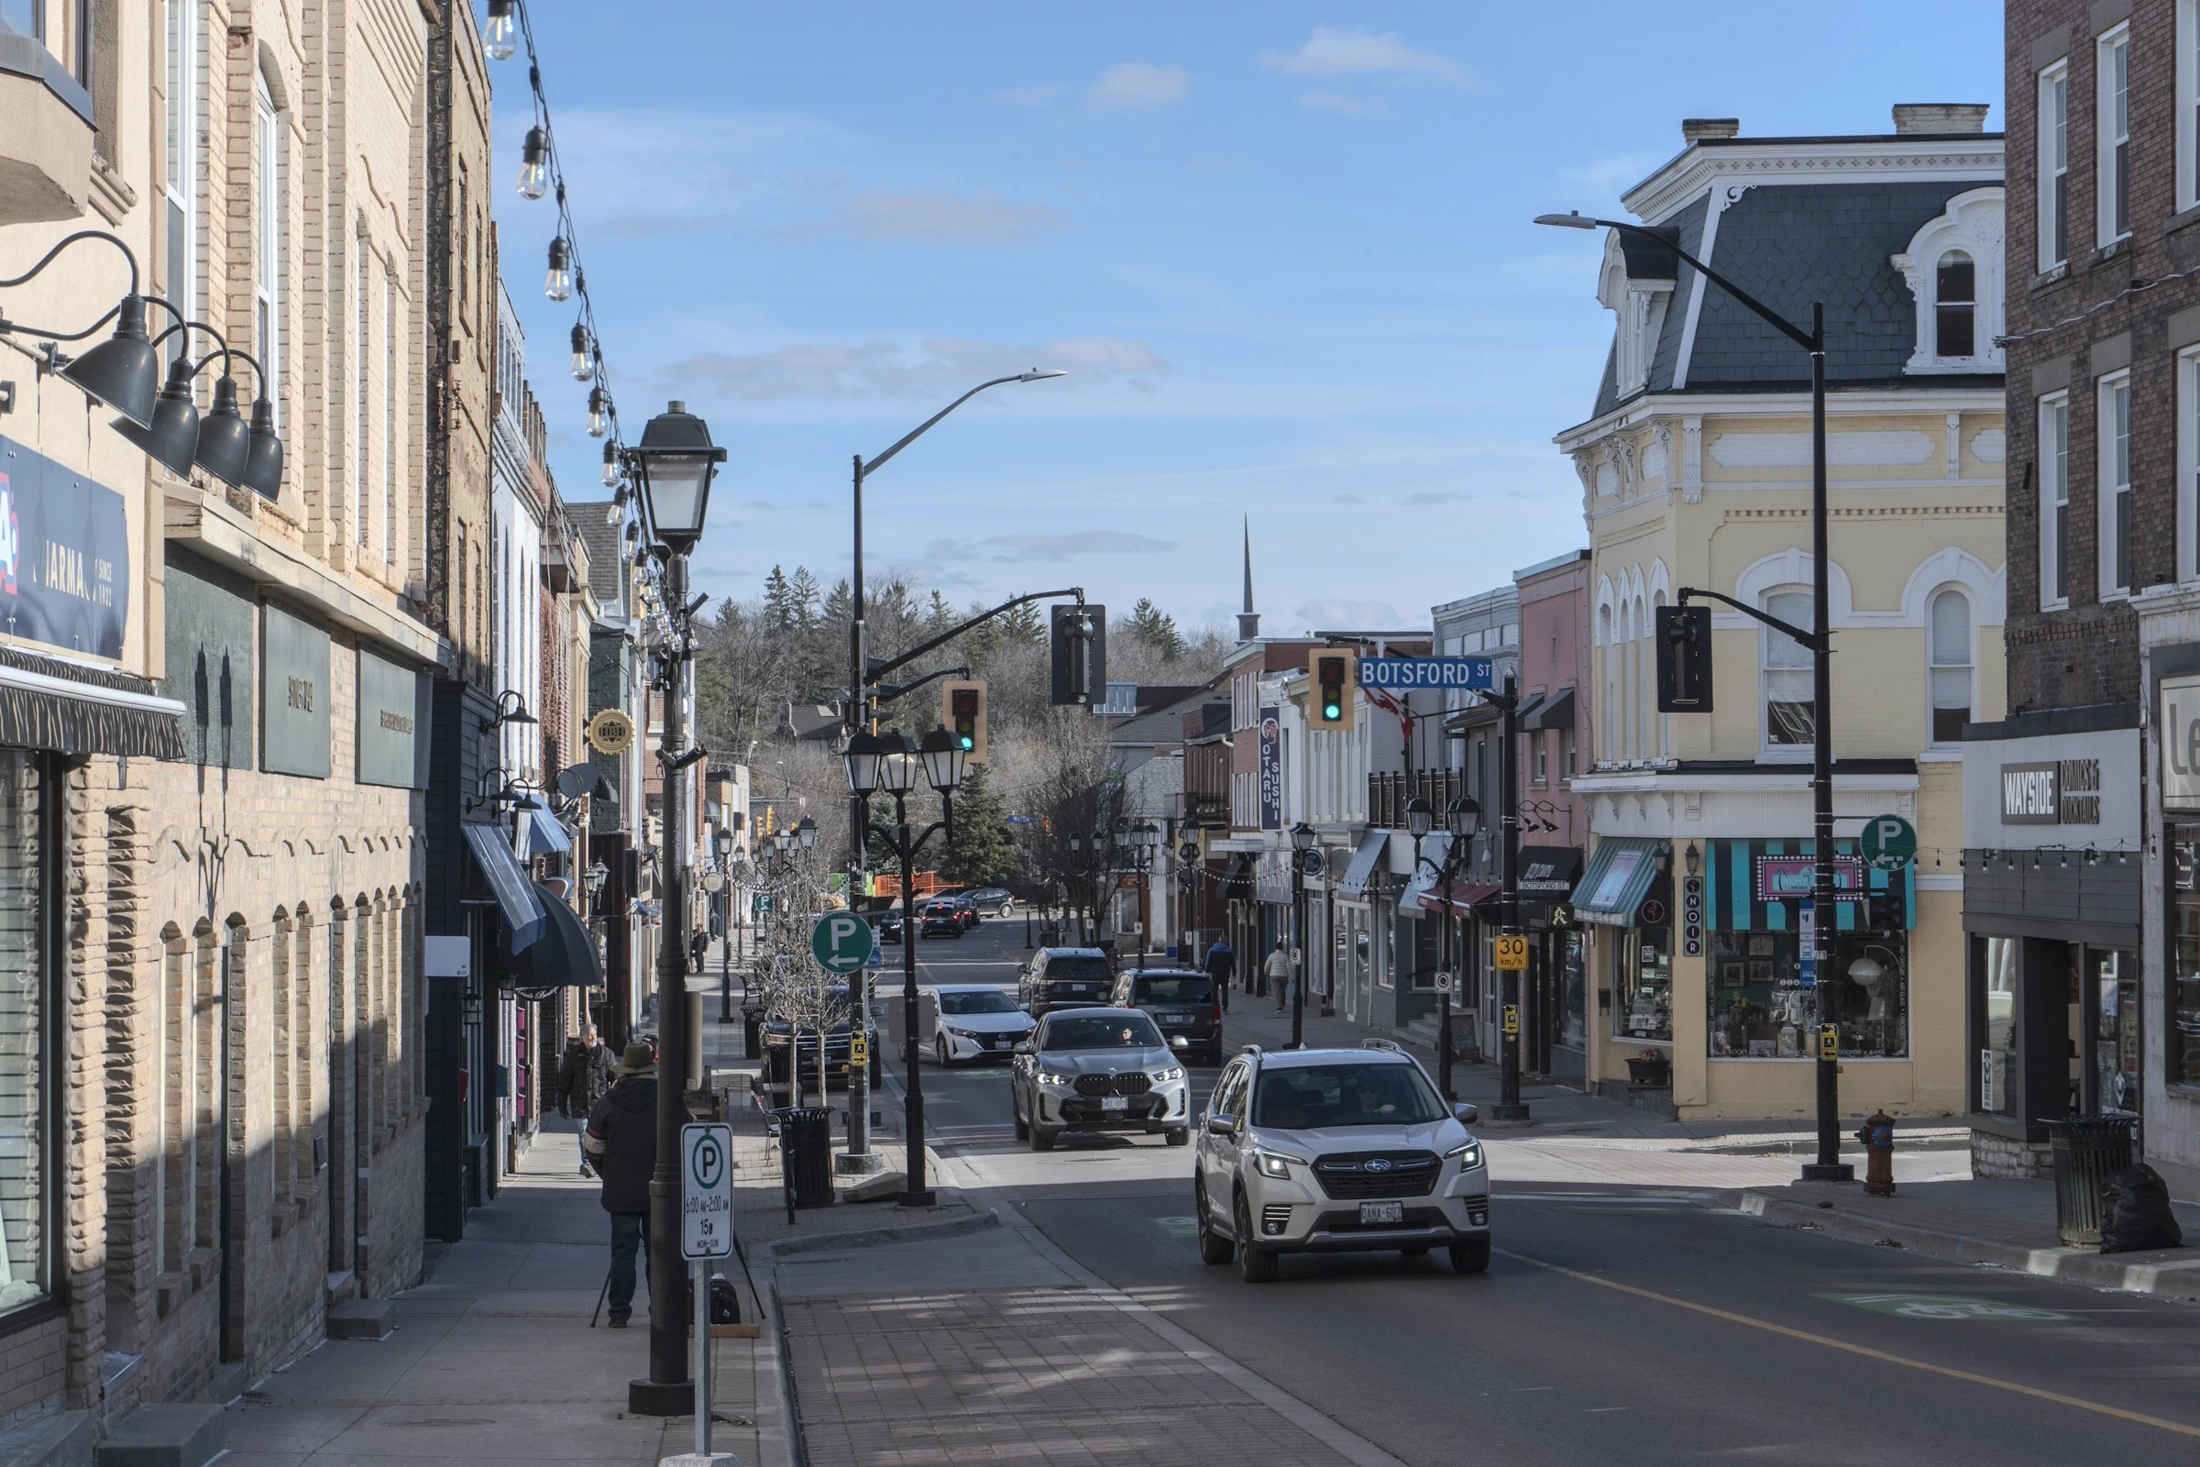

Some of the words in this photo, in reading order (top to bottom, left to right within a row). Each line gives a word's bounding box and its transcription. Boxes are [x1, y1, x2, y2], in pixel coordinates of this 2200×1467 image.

[99, 558, 112, 582] SINCE
[1362, 662, 1470, 685] BOTSFORD
[1476, 664, 1491, 677] ST
[600, 727, 625, 737] HBH
[1262, 744, 1271, 803] OTARU
[2062, 759, 2090, 791] COMICS
[1272, 762, 1280, 821] SUSHI
[2004, 771, 2054, 815] WAYSIDE
[2062, 796, 2100, 825] COCKTAILS
[1878, 820, 1902, 850] P
[761, 896, 769, 905] P
[830, 918, 857, 951] P
[1688, 897, 1698, 952] NOIR
[1500, 939, 1524, 955] 30
[1500, 957, 1523, 967] km/h
[702, 1146, 717, 1178] P
[686, 1197, 699, 1214] 6:00
[700, 1219, 709, 1236] 15
